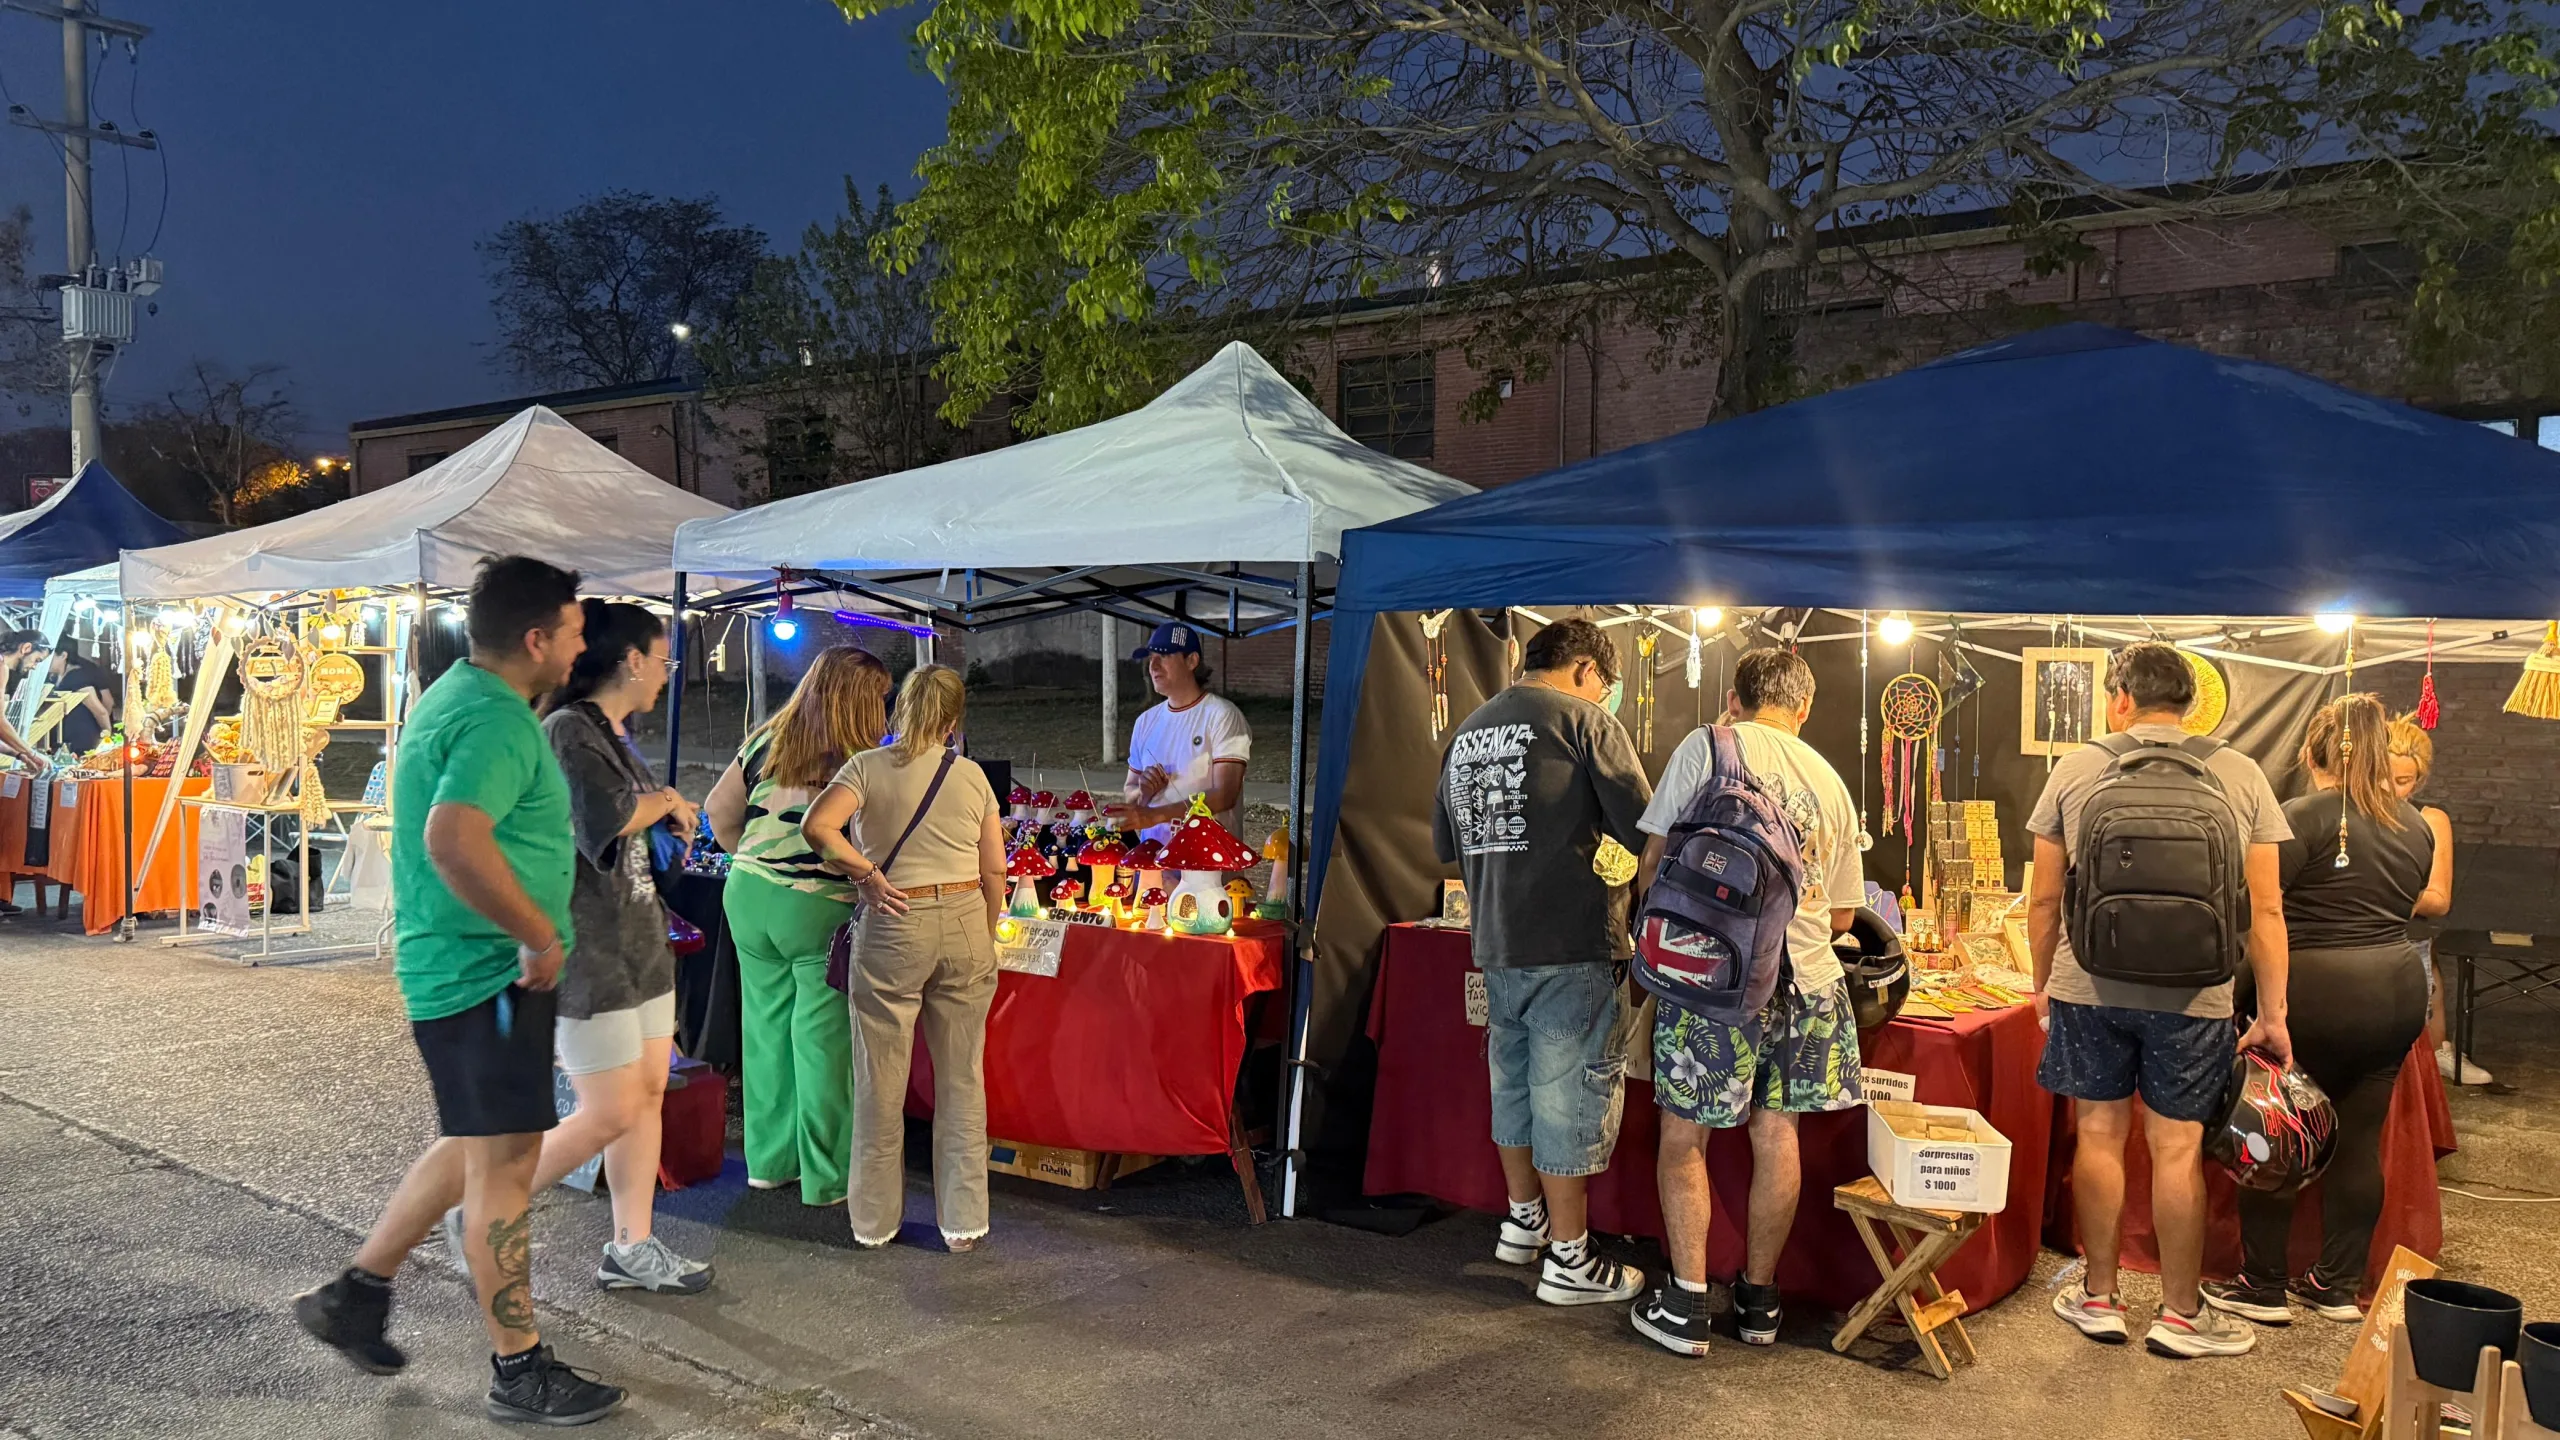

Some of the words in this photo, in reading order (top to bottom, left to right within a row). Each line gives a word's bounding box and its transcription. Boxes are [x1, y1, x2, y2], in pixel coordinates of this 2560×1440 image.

[1450, 724, 1531, 762] ESSENCE
[1021, 925, 1060, 938] mercado
[1466, 988, 1487, 1002] TAR
[1871, 1076, 1909, 1090] surtidos
[1918, 1149, 1974, 1161] Sorpresitas
[1920, 1165, 1942, 1175] para
[1944, 1165, 1971, 1176] niños
[1924, 1179, 1931, 1190] $
[1934, 1180, 1956, 1191] 1000
